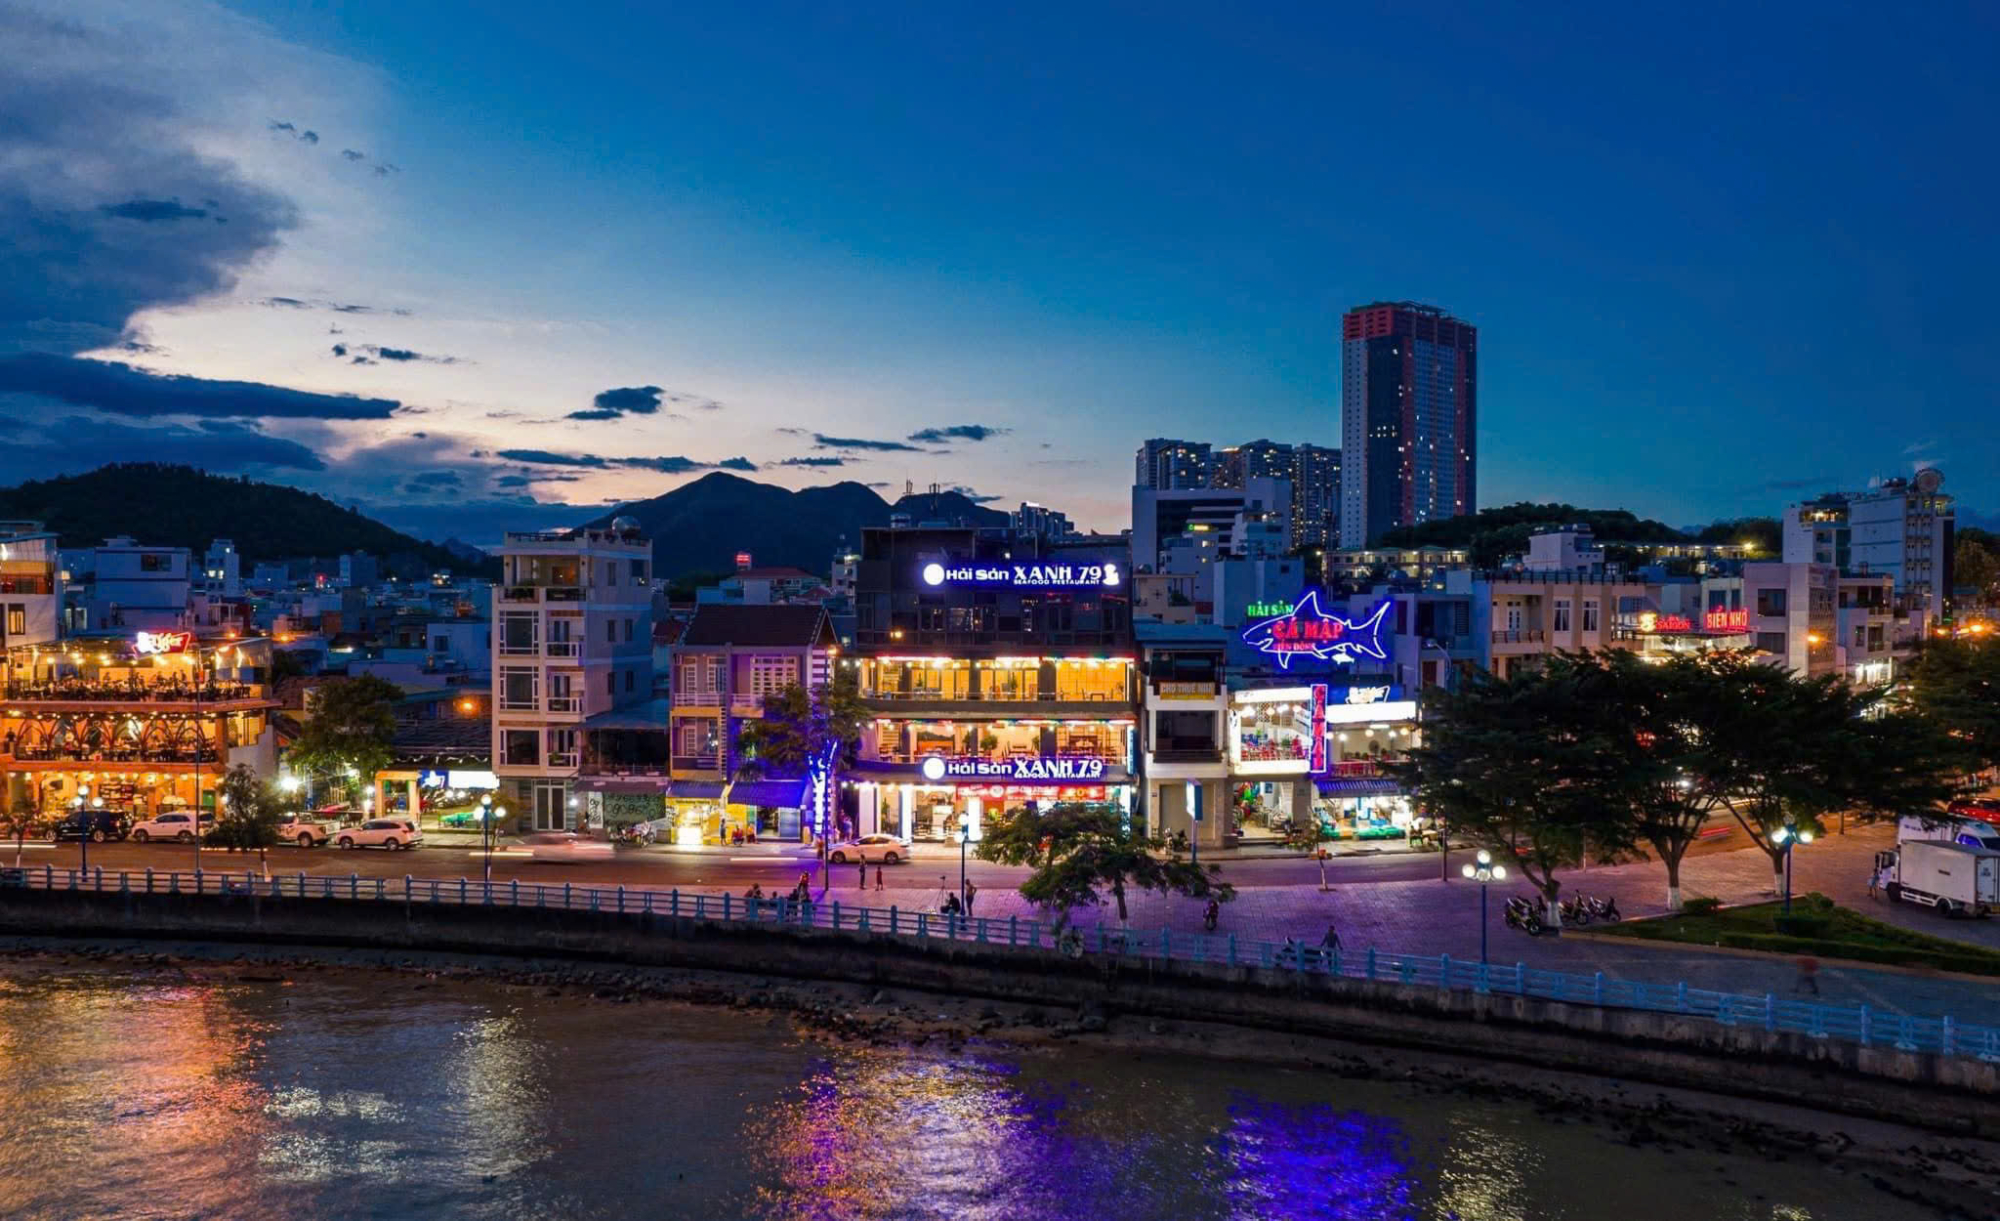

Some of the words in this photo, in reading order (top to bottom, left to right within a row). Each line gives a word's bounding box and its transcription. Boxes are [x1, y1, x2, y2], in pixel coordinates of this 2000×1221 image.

[1013, 566, 1070, 580] XANH
[1077, 566, 1102, 580] 79
[1272, 617, 1299, 639] CÁ
[1014, 759, 1071, 775] XANH
[1075, 760, 1103, 775] 79
